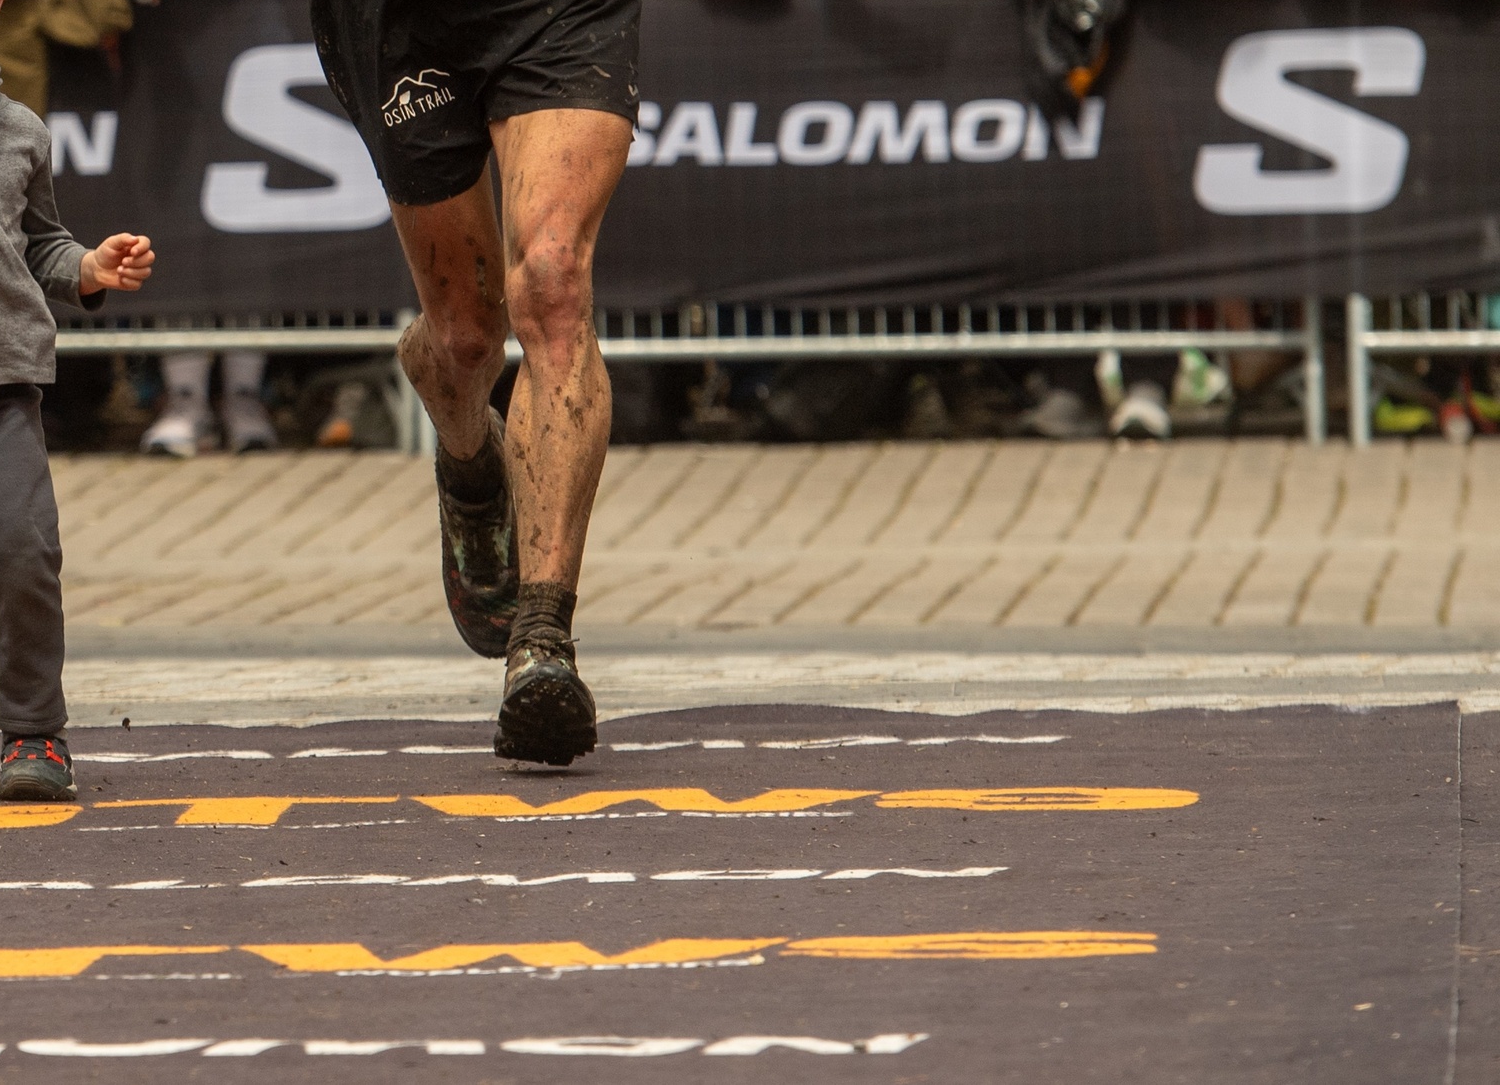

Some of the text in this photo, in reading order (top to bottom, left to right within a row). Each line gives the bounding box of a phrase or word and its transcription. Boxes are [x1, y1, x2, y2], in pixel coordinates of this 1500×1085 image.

[384, 86, 456, 127] OSIN TRAIL
[1193, 25, 1427, 216] S
